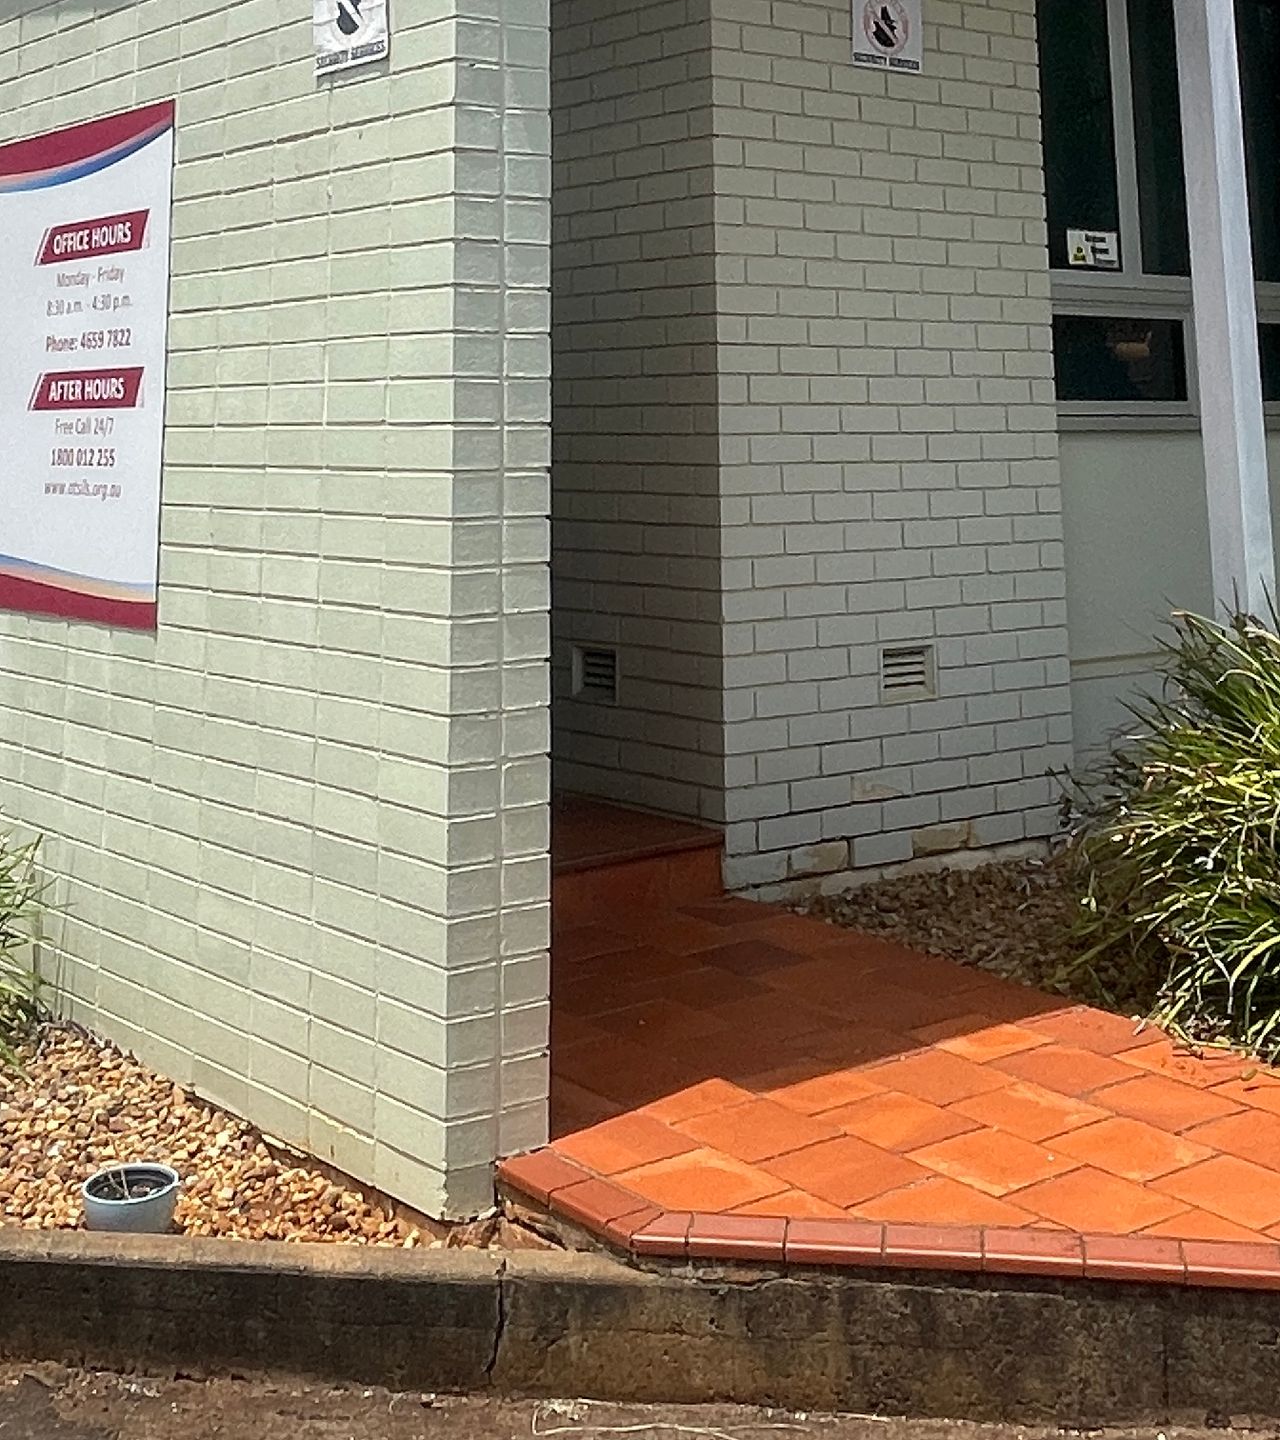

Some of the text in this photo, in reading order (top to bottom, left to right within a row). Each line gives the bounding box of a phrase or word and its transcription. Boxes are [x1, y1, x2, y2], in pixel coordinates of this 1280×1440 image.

[53, 221, 132, 255] OFFICE HOURS
[56, 271, 91, 289] Monday
[97, 265, 125, 284] Friday
[46, 300, 65, 317] 8:30
[91, 294, 112, 311] 4:30
[113, 295, 133, 312] p.m.
[46, 328, 132, 352] Phone: 4659 7822
[48, 378, 125, 402] AFTER HOURS
[55, 417, 114, 438] Free Call 24/7
[50, 448, 116, 467] 1800 012 255
